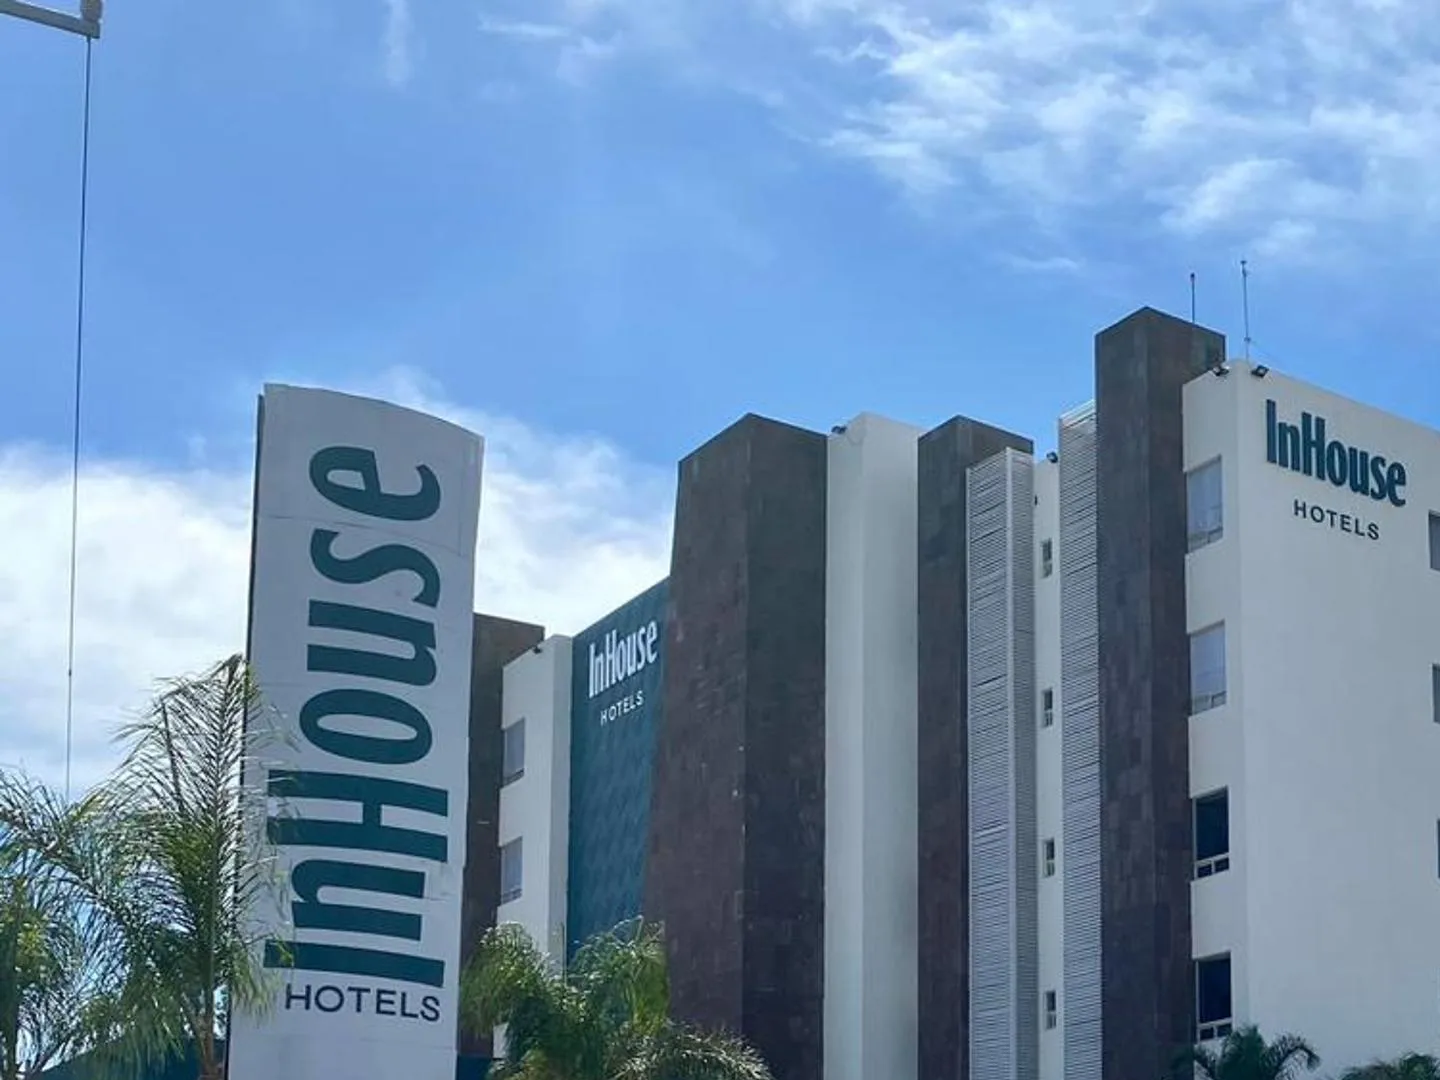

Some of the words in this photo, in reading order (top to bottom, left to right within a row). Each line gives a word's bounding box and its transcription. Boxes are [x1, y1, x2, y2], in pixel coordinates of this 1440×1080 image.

[1266, 399, 1407, 507] InHouse
[1293, 499, 1380, 541] HOTELS
[588, 620, 658, 699] InHouse
[262, 445, 448, 988] InHouse
[600, 690, 644, 727] HOTELS
[284, 983, 441, 1023] HOTELS
